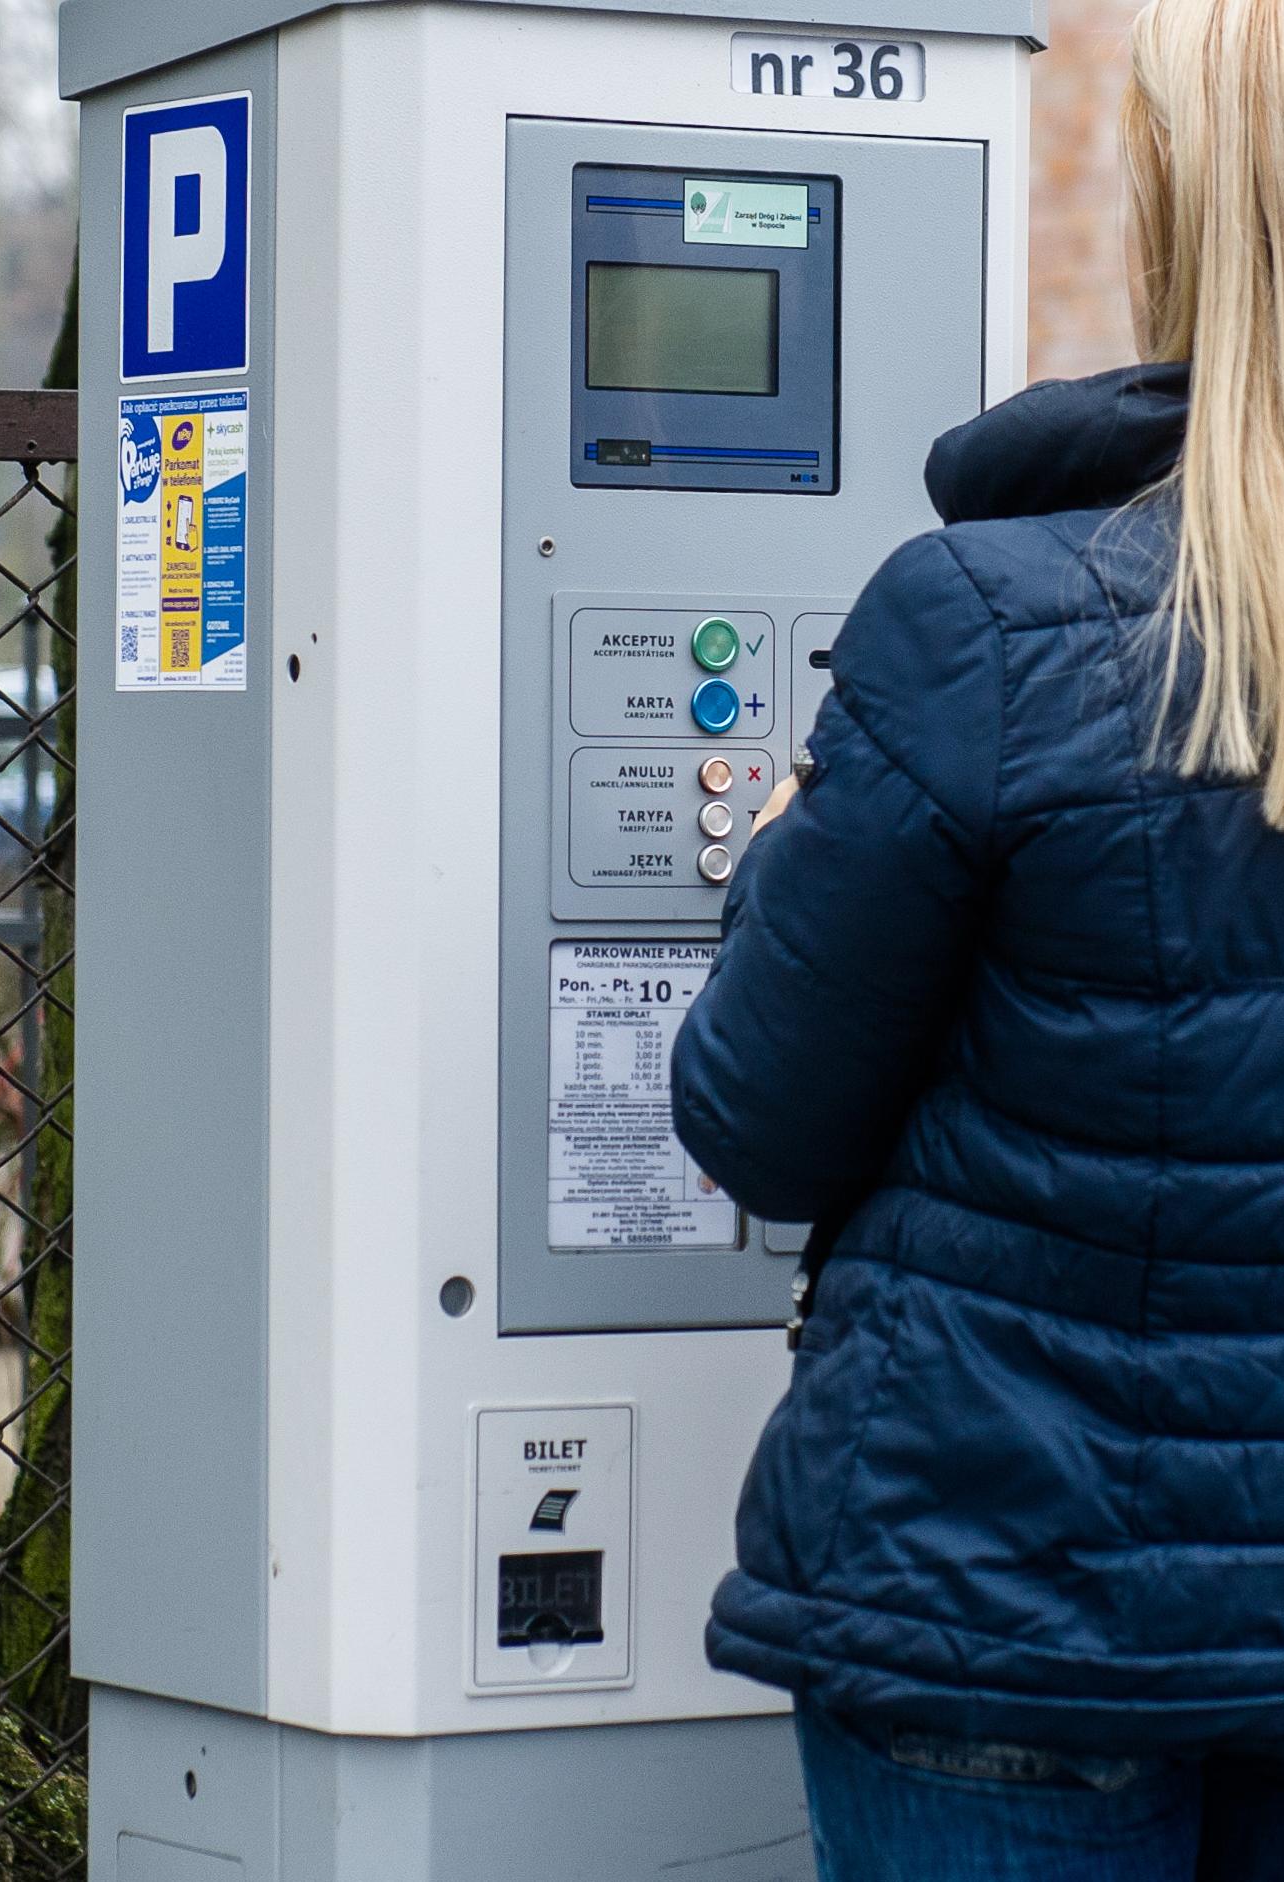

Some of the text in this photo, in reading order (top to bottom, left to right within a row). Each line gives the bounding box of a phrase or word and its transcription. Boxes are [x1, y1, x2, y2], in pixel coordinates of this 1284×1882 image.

[751, 42, 903, 99] nr 36
[734, 211, 757, 219] Zarząd
[758, 212, 775, 222] Dróg
[758, 221, 785, 230] Sopocie
[147, 125, 227, 353] P
[122, 394, 247, 415] Jak opłacić parkowanie przez telefon?
[216, 423, 244, 437] skycash
[170, 474, 203, 486] telefonie
[602, 634, 675, 647] AKCEPTUJ
[627, 696, 674, 709] KARTA
[624, 711, 674, 719] CARD/KARTE
[618, 766, 674, 778] ANULUJ
[618, 810, 673, 822] TARYFA
[619, 825, 673, 833] TARIFF/TARIF
[629, 854, 673, 869] JĘZYK
[574, 947, 718, 959] PARKOWANIE PŁATNE
[560, 978, 594, 992] Pon.
[613, 979, 634, 992] Pt.
[640, 980, 672, 1002] 10
[587, 1031, 603, 1039] min.
[636, 1031, 653, 1039] 0,50
[575, 1041, 603, 1049] 30 min.
[637, 1041, 653, 1050] 1,50
[582, 1052, 603, 1061] godz.
[582, 1062, 603, 1071] godz.
[582, 1073, 603, 1082] godz.
[524, 1440, 587, 1460] BILET
